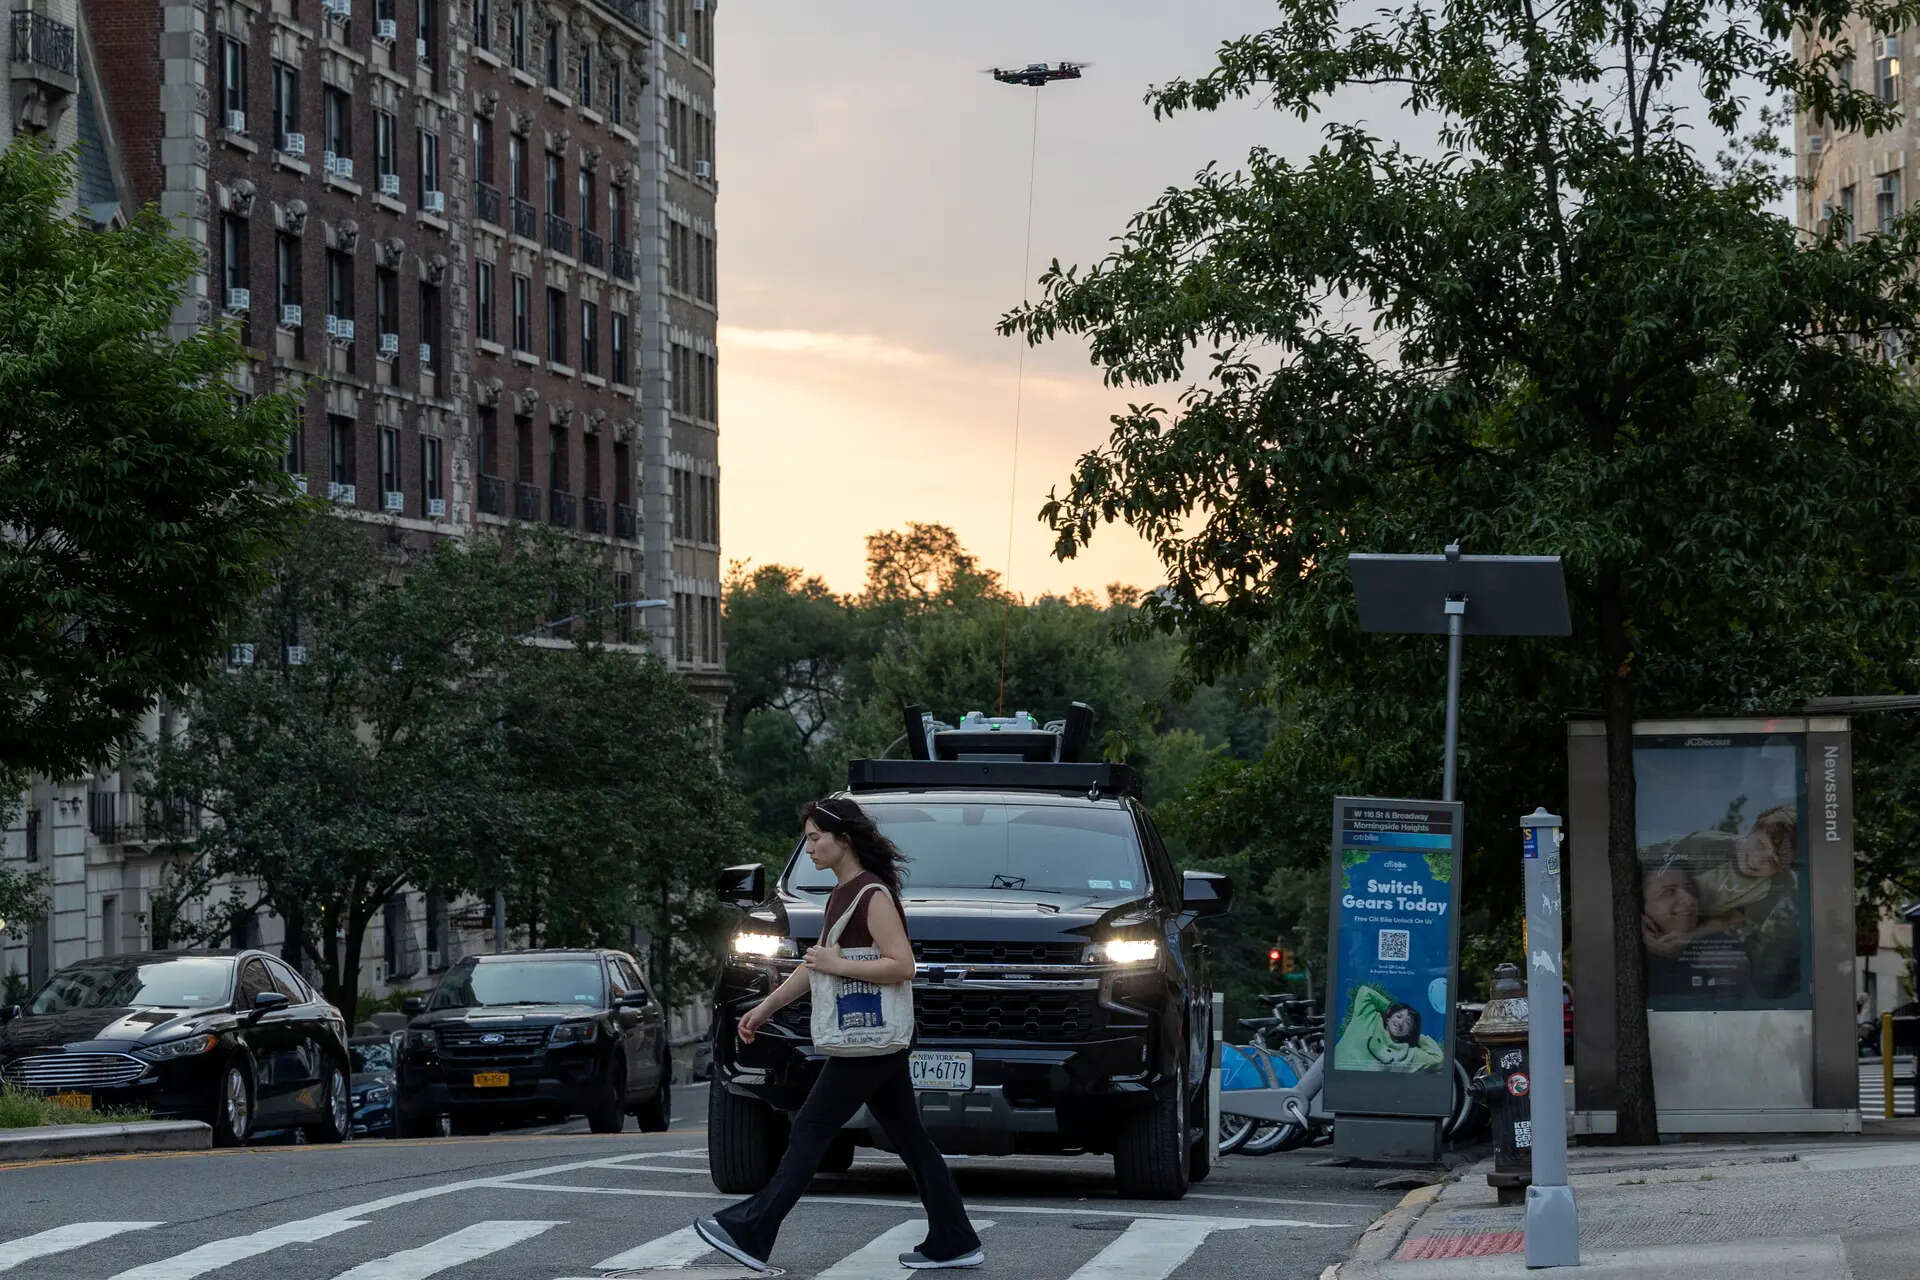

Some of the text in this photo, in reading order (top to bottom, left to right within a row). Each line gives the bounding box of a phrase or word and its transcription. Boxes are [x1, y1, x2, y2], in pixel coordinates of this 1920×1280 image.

[1684, 737, 1732, 747] JCDecaux
[1823, 745, 1841, 842] Newsstand
[1375, 811, 1384, 819] St
[1391, 812, 1430, 822] Broadway
[1353, 821, 1430, 833] Morningside Heights
[1367, 879, 1424, 895] Switch
[1342, 894, 1448, 915] Gears Today
